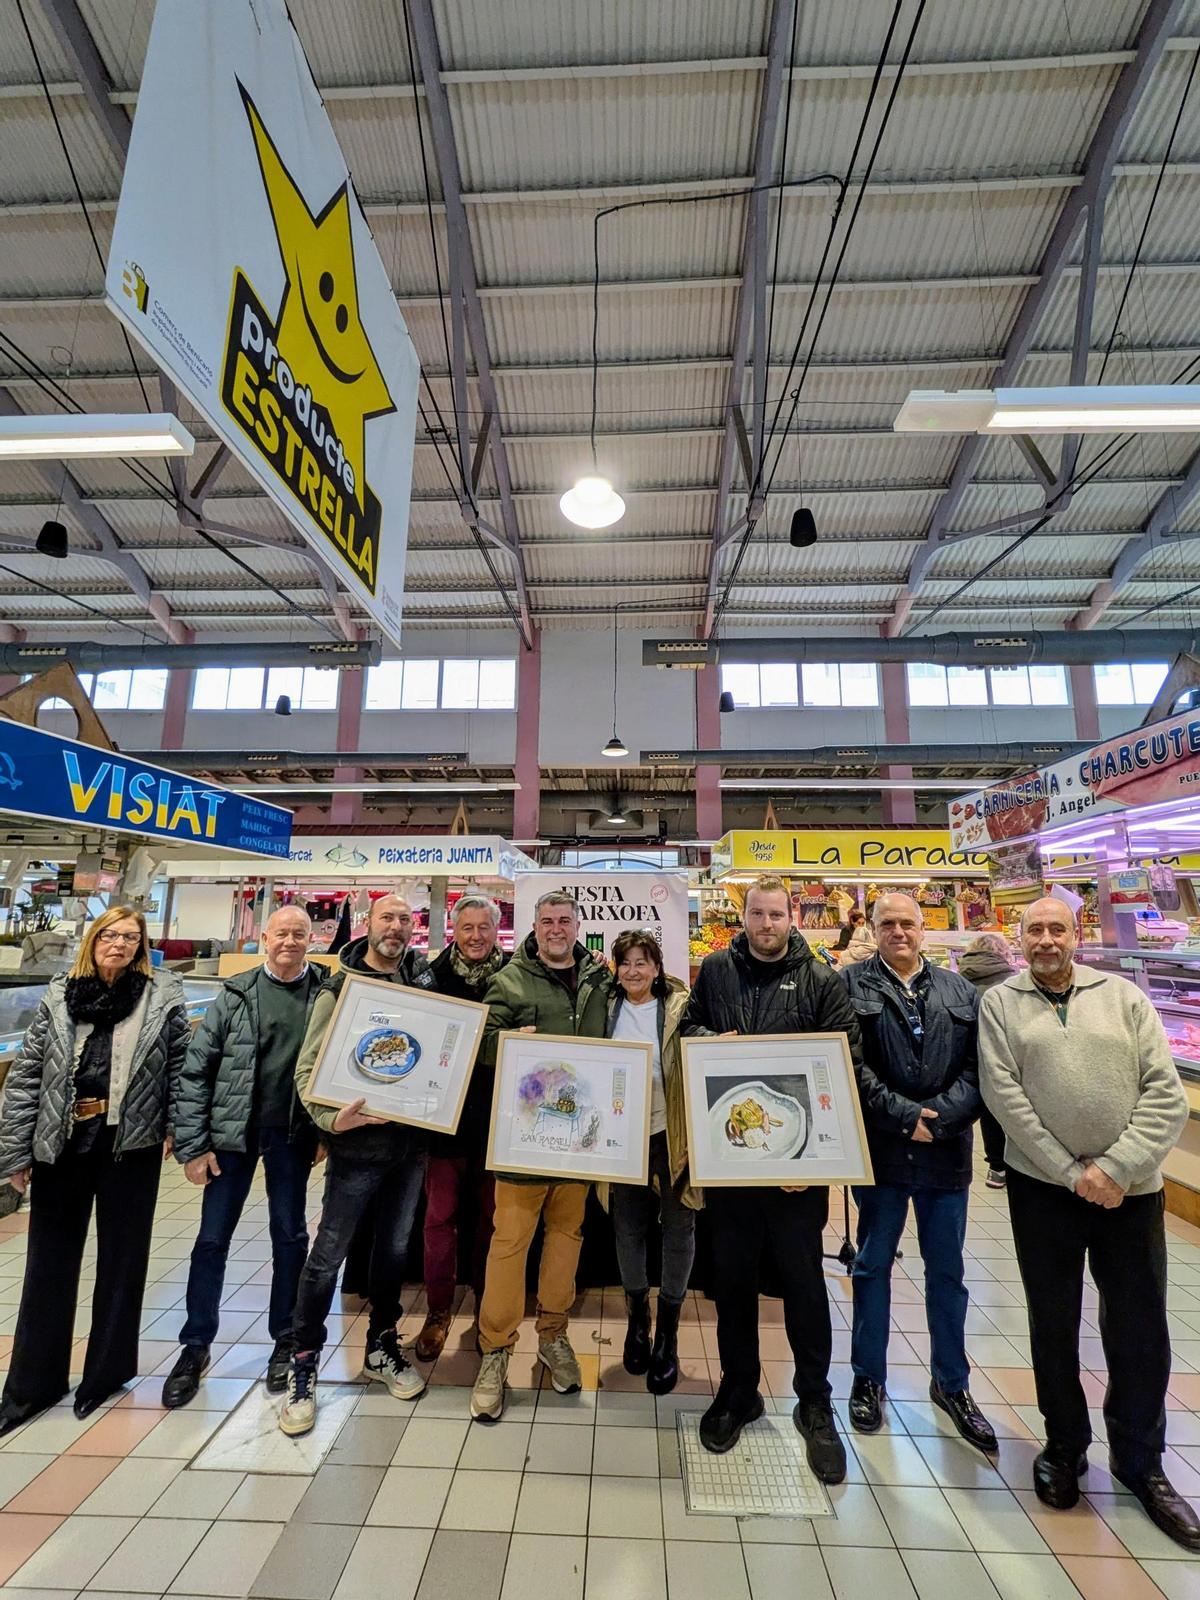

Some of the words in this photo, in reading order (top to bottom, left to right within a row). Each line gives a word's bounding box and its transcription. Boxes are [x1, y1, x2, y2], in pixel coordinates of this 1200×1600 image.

[241, 303, 355, 495] producte
[232, 351, 373, 586] ESTRELLA
[62, 749, 227, 838] VISIAT
[242, 802, 261, 817] PEIX
[264, 809, 289, 824] FRESC
[1045, 806, 1056, 823] J.
[1060, 791, 1096, 813] Angel
[240, 819, 273, 835] MARISC
[239, 835, 287, 854] CONGELATS
[749, 840, 776, 853] Desde
[792, 838, 841, 865] La
[289, 849, 312, 862] ercat
[378, 846, 443, 864] Peixateria
[446, 847, 493, 865] JUANITA
[755, 852, 773, 862] 1958
[577, 904, 662, 921] ARXOFA
